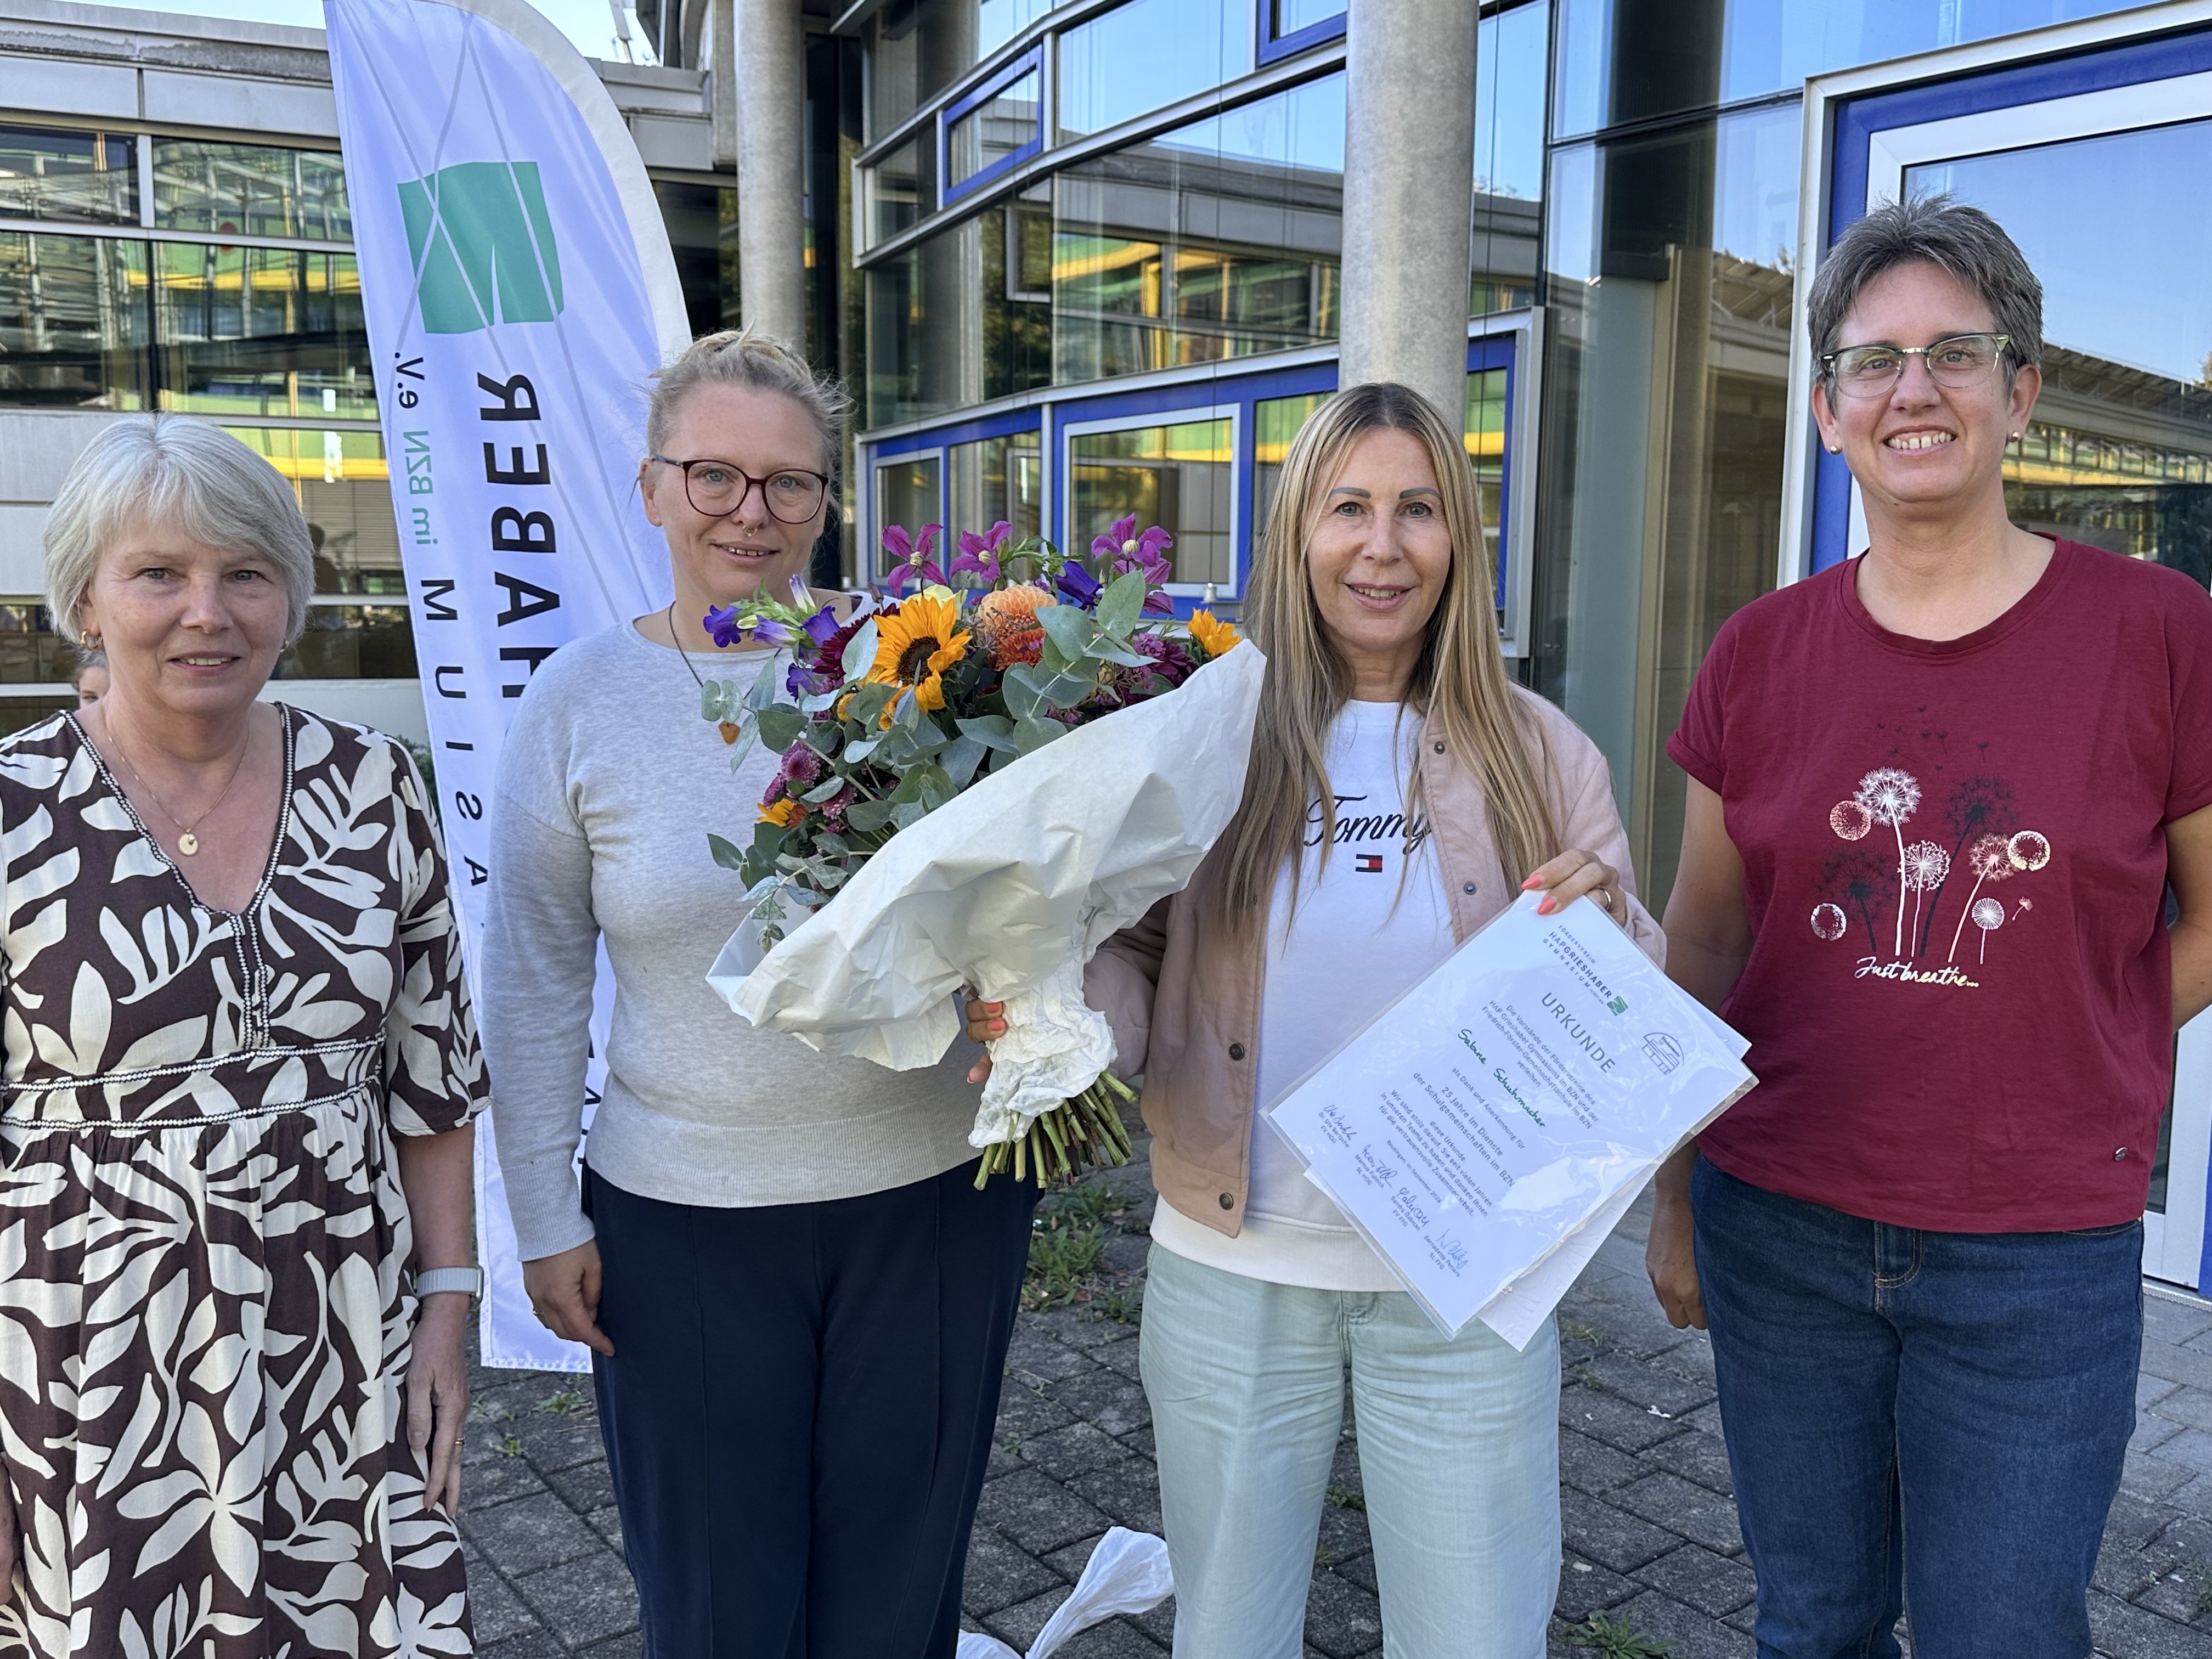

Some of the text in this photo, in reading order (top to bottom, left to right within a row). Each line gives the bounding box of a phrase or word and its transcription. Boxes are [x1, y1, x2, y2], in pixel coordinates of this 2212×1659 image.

[1304, 795, 1432, 855] Tommy
[1543, 938, 1590, 988] GYMNASIUM
[1549, 932, 1611, 997] HAPGRIESHABER
[1854, 956, 1899, 978] Just
[1489, 1000, 1599, 1121] HAP Grieshaber Gymnasiums im BZN und der
[1506, 1005, 1595, 1105] Die Vorstände der Fördervereine des
[1542, 992, 1615, 1072] URKUNDE
[1451, 1067, 1525, 1149] als Dank und Anerkennung für
[1457, 1029, 1545, 1126] Sabine Schuhmacher
[1517, 1060, 1541, 1086] verleihen
[1379, 1105, 1388, 1115] für
[1386, 1115, 1396, 1125] die
[1395, 1125, 1432, 1167] vertrauensvolle
[1391, 1090, 1401, 1101] Wir
[1400, 1101, 1413, 1114] sind
[1410, 1114, 1424, 1128] stolz
[1441, 1147, 1450, 1158] Sie
[1449, 1158, 1460, 1170] seit
[1459, 1169, 1475, 1187] vielen
[1473, 1186, 1492, 1206] Jahren
[1413, 1073, 1515, 1187] der Schulgemeinschaften im BZN
[1429, 1121, 1444, 1137] diese
[1441, 1086, 1503, 1156] 25 Jahre im Dienste
[1571, 1106, 1580, 1116] im
[1579, 1114, 1592, 1129] BZN
[1380, 1092, 1487, 1216] in unseren Teams zu haben und danken Ihnen
